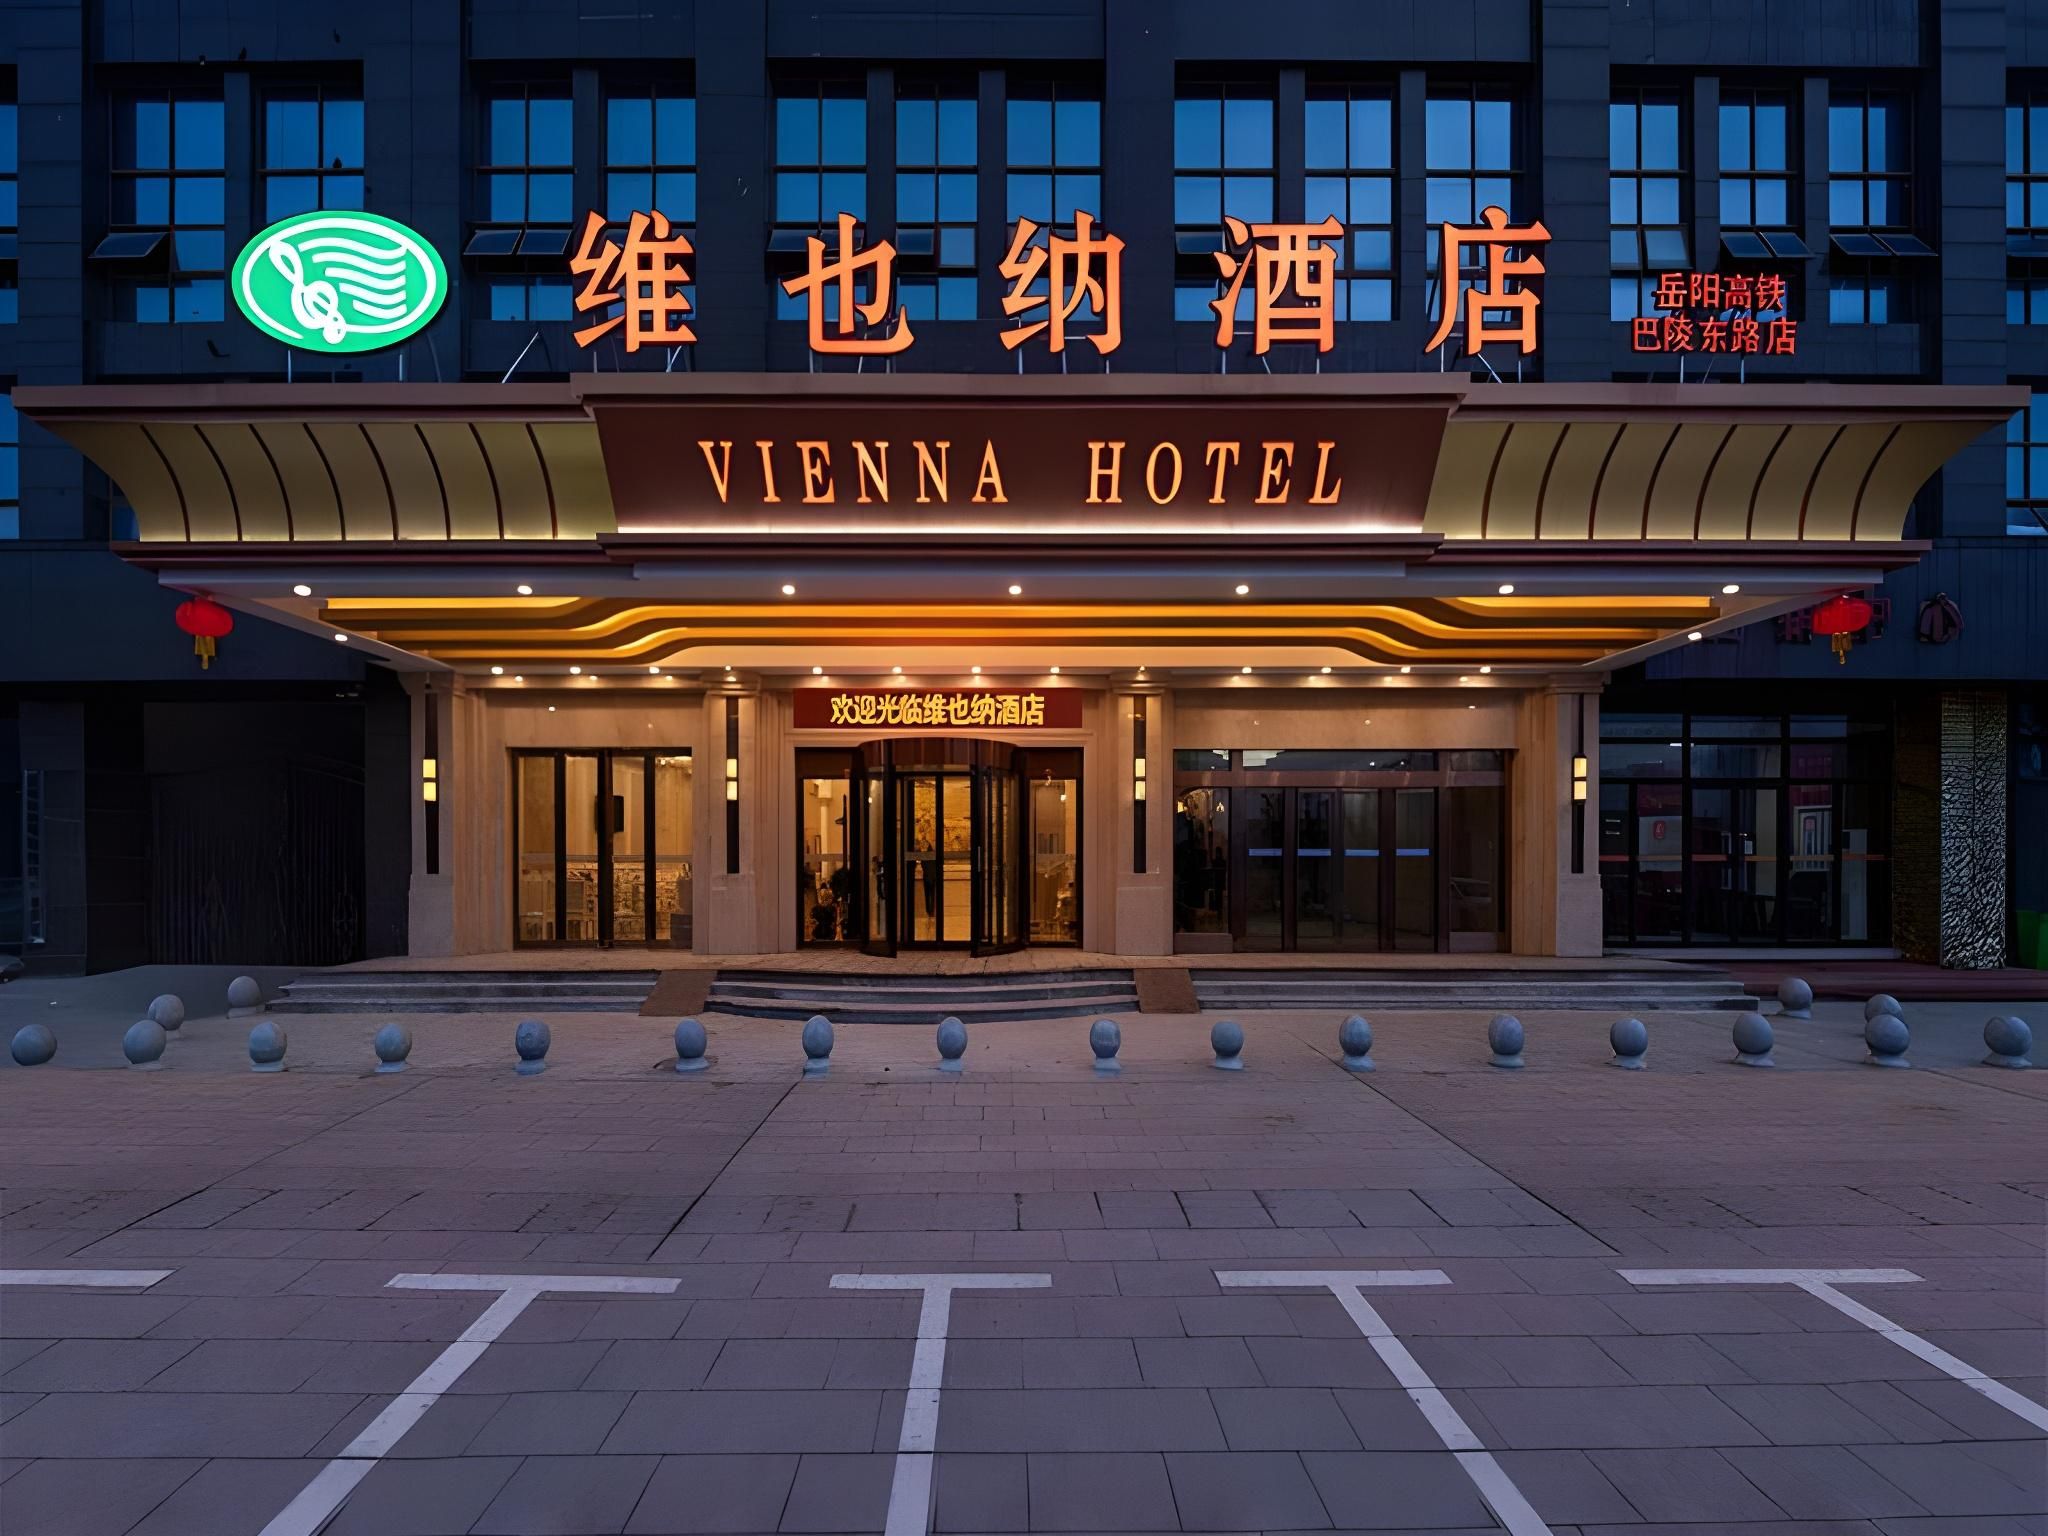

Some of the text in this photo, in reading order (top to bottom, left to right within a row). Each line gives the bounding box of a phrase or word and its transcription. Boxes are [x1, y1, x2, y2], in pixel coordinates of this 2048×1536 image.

[570, 206, 1551, 355] 维也纳酒店
[1655, 272, 1786, 310] 岳阳高铁
[1632, 316, 1798, 354] 巴陵东路店
[697, 440, 1343, 506] VIENNA HOTEL
[829, 692, 1046, 726] 欢迎光临维也纳酒店
